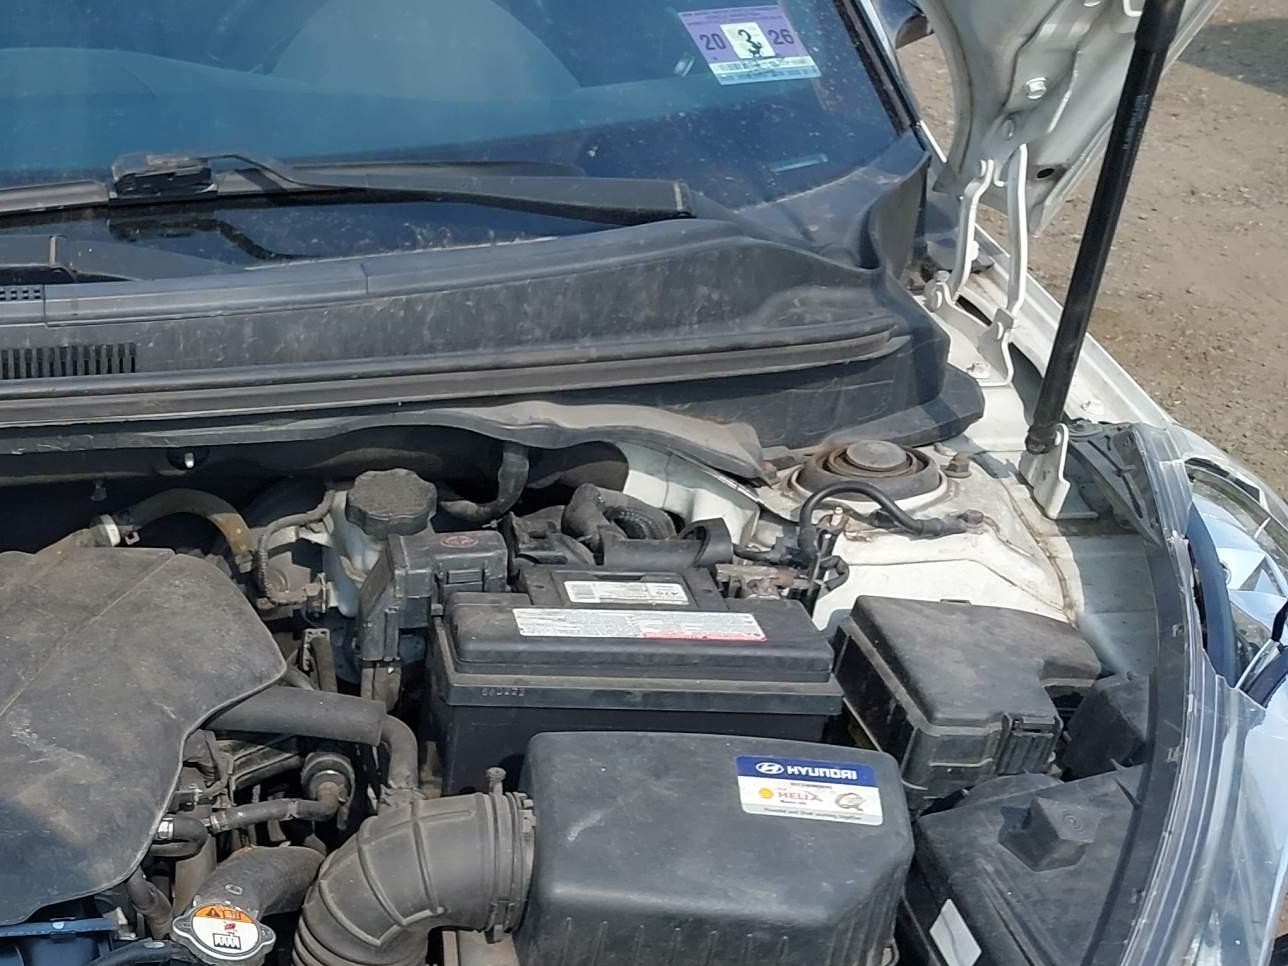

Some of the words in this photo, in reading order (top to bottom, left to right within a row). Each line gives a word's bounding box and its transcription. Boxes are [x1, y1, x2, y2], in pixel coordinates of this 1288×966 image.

[699, 33, 727, 51] 20
[768, 28, 795, 46] 26
[787, 764, 858, 780] HYUNDAI
